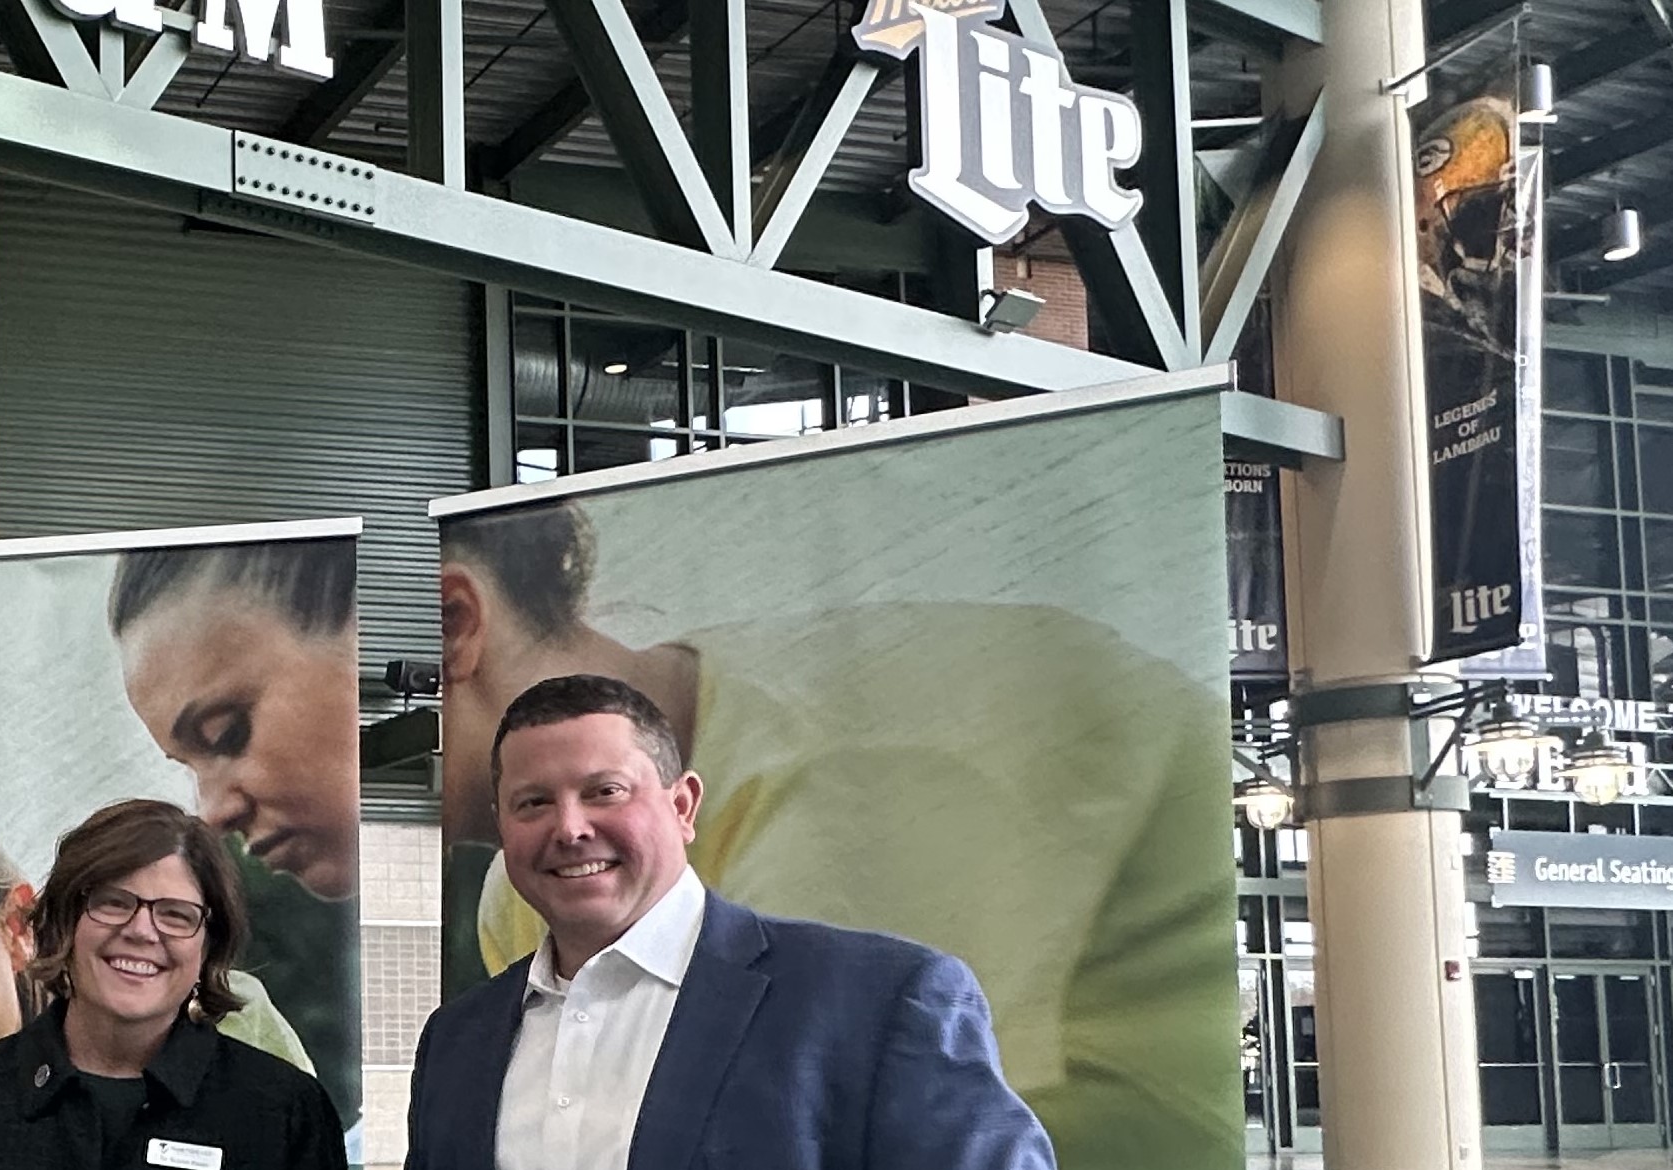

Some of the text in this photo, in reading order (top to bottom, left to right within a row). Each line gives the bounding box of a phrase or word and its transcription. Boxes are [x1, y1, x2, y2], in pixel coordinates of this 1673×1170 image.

[913, 2, 1141, 234] Lite
[1458, 418, 1479, 437] OF
[1224, 463, 1271, 477] TIONS
[1450, 583, 1512, 634] Lite
[1227, 619, 1278, 660] ite
[1535, 857, 1606, 883] General
